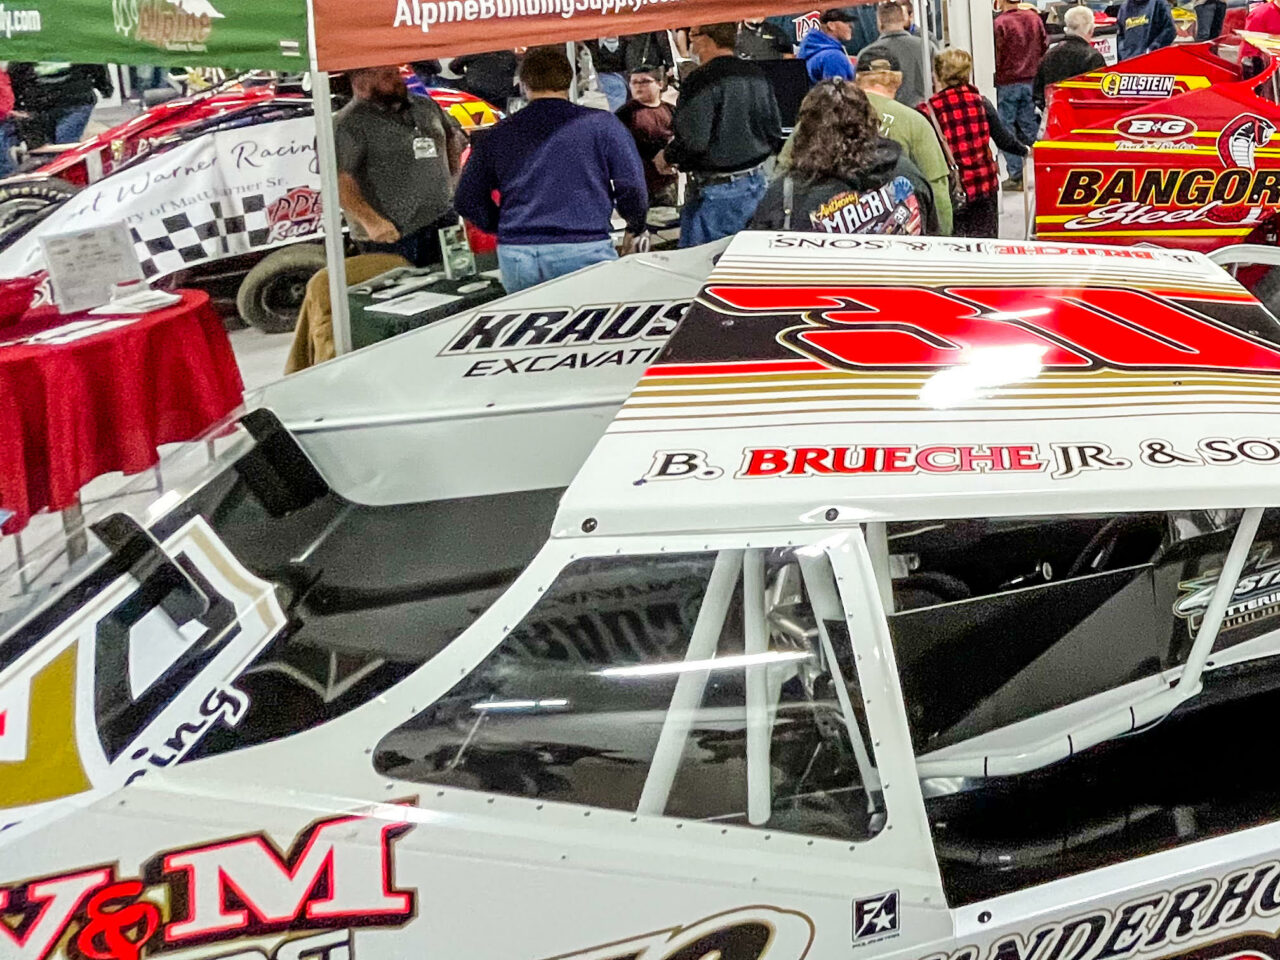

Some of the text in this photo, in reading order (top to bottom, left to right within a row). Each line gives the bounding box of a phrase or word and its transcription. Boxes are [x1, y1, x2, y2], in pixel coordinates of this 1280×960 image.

[1119, 76, 1174, 91] BILSTEIN
[117, 155, 219, 203] Warner
[230, 135, 321, 174] Racing
[1064, 200, 1224, 230] Steel
[768, 236, 886, 251] SONS
[999, 245, 1155, 261] BRUECHE
[448, 301, 692, 352] KRAUS
[461, 346, 662, 378] EXCAVATI
[652, 451, 719, 478] B.
[740, 443, 1043, 477] BRUECHE
[1050, 444, 1132, 477] JR.
[1142, 441, 1190, 466] &
